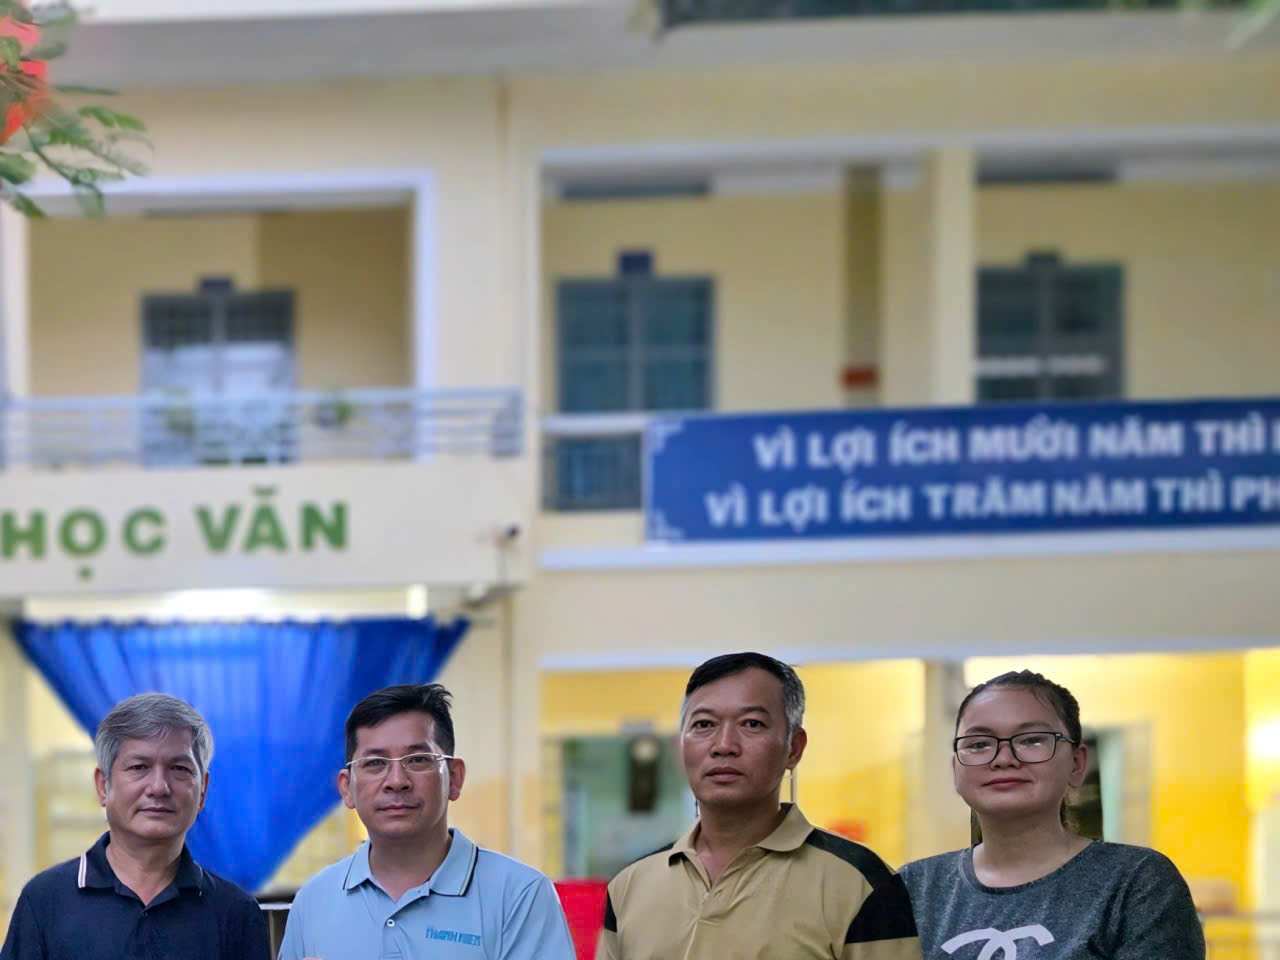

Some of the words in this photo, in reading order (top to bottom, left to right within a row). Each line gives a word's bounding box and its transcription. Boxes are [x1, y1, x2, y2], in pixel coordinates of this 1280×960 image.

[753, 426, 795, 470] VÌ
[806, 426, 876, 474] LỢI
[888, 420, 960, 466] ÍCH
[1193, 411, 1266, 455] THÌ
[193, 485, 348, 554] VĂN
[704, 481, 747, 528] VÌ
[758, 482, 829, 532] LỢI
[840, 477, 912, 522] ÍCH
[923, 475, 1046, 520] TRĂM
[1154, 467, 1225, 513] THÌ
